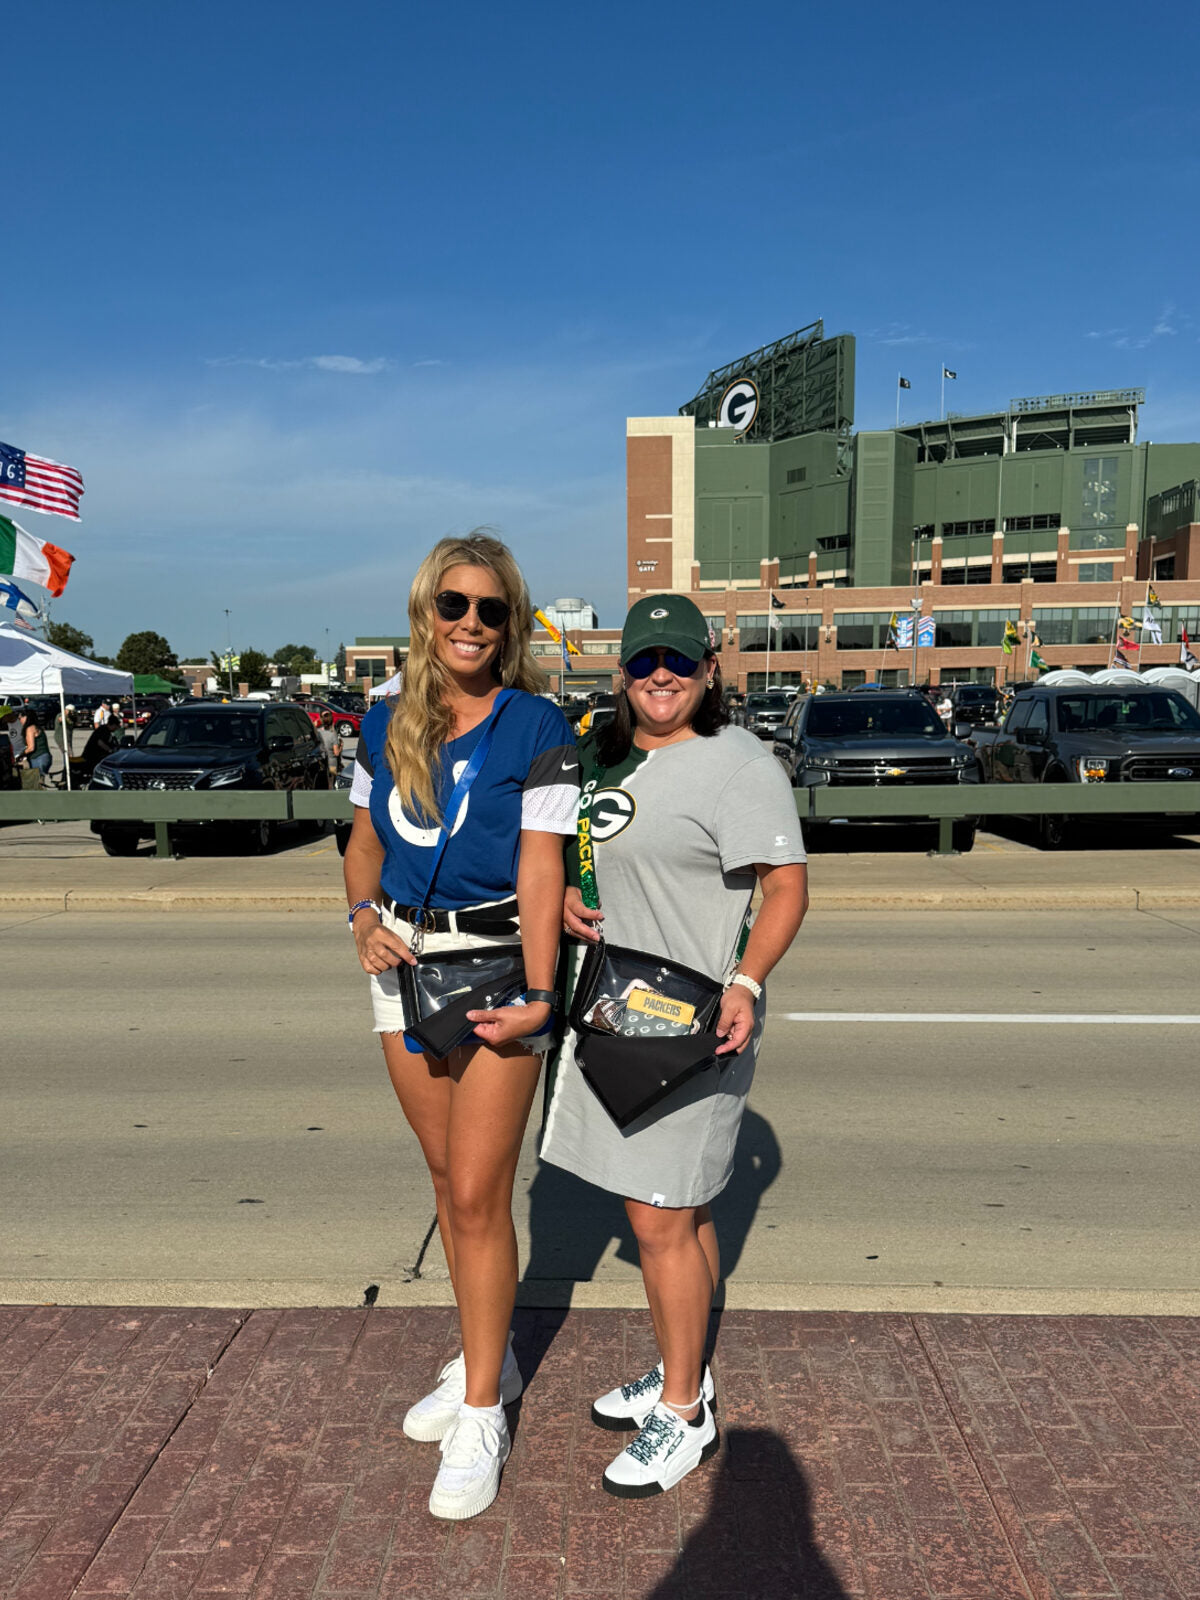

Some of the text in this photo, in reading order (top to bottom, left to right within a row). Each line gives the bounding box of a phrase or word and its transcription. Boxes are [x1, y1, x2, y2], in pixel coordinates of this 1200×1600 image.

[720, 383, 757, 430] G
[650, 608, 670, 620] G
[577, 780, 598, 876] GO PACK
[591, 791, 632, 840] G
[643, 996, 682, 1017] PACKERS
[655, 1023, 666, 1031] G
